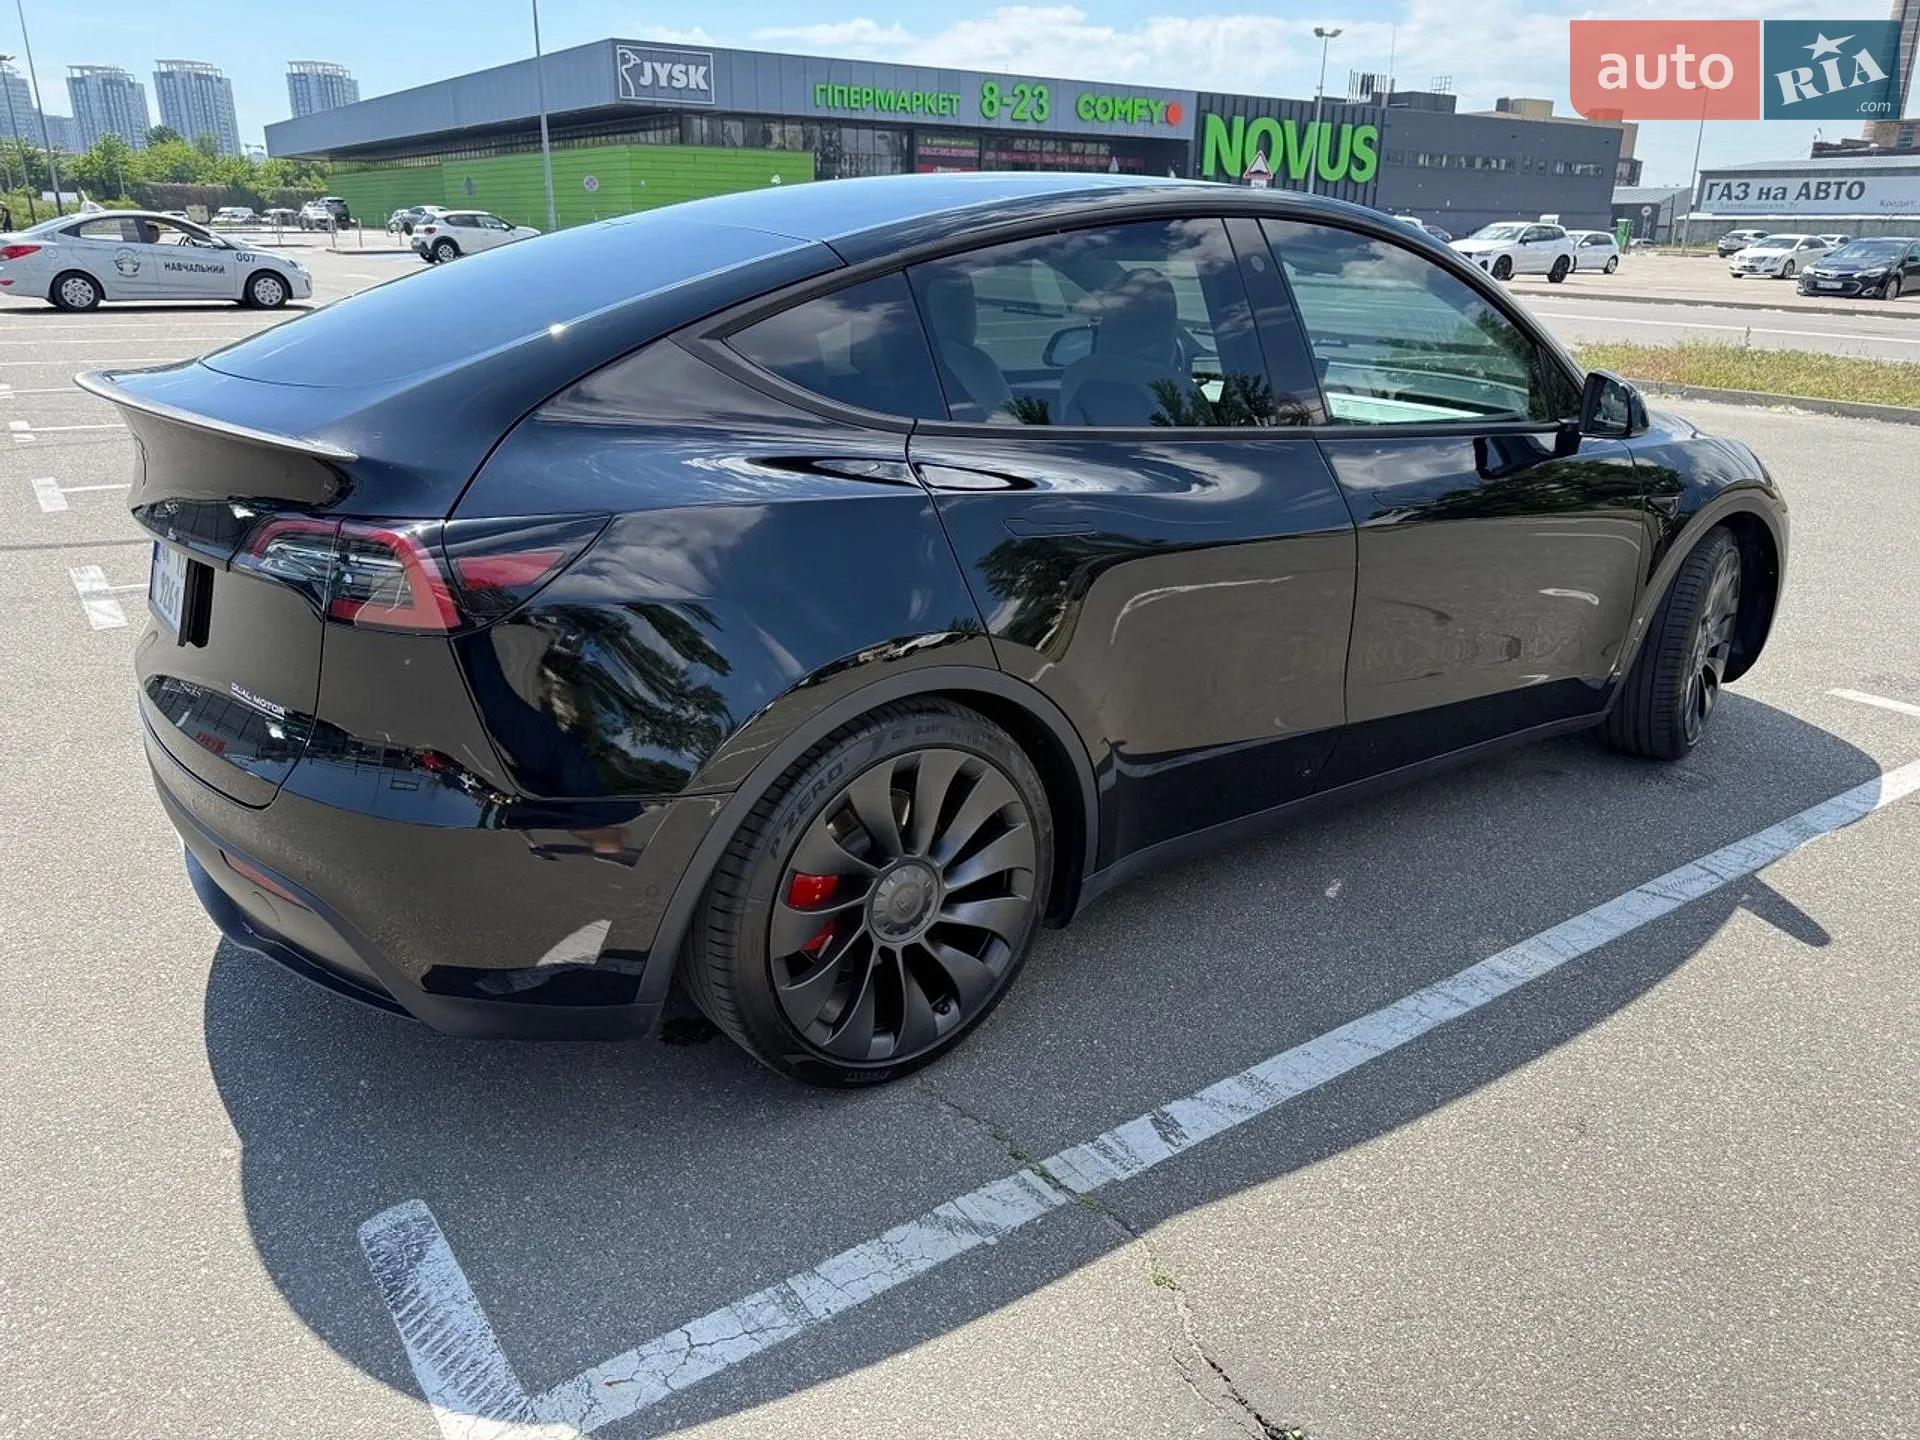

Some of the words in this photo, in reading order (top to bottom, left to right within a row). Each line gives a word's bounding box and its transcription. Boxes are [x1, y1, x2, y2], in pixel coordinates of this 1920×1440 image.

[639, 61, 709, 91] JYSK
[813, 83, 960, 117] ГІПЕРМАРКЕТ
[980, 80, 1051, 123] 8-23
[1075, 92, 1166, 127] COMFY
[1202, 113, 1379, 184] NOVUS
[1706, 181, 1751, 201] ГАЗ
[1757, 185, 1788, 201] на
[1794, 180, 1866, 201] АВТО
[164, 261, 225, 274] НАВЧАЛЬНИЙ
[235, 252, 257, 264] 007
[253, 695, 285, 716] MOTOR
